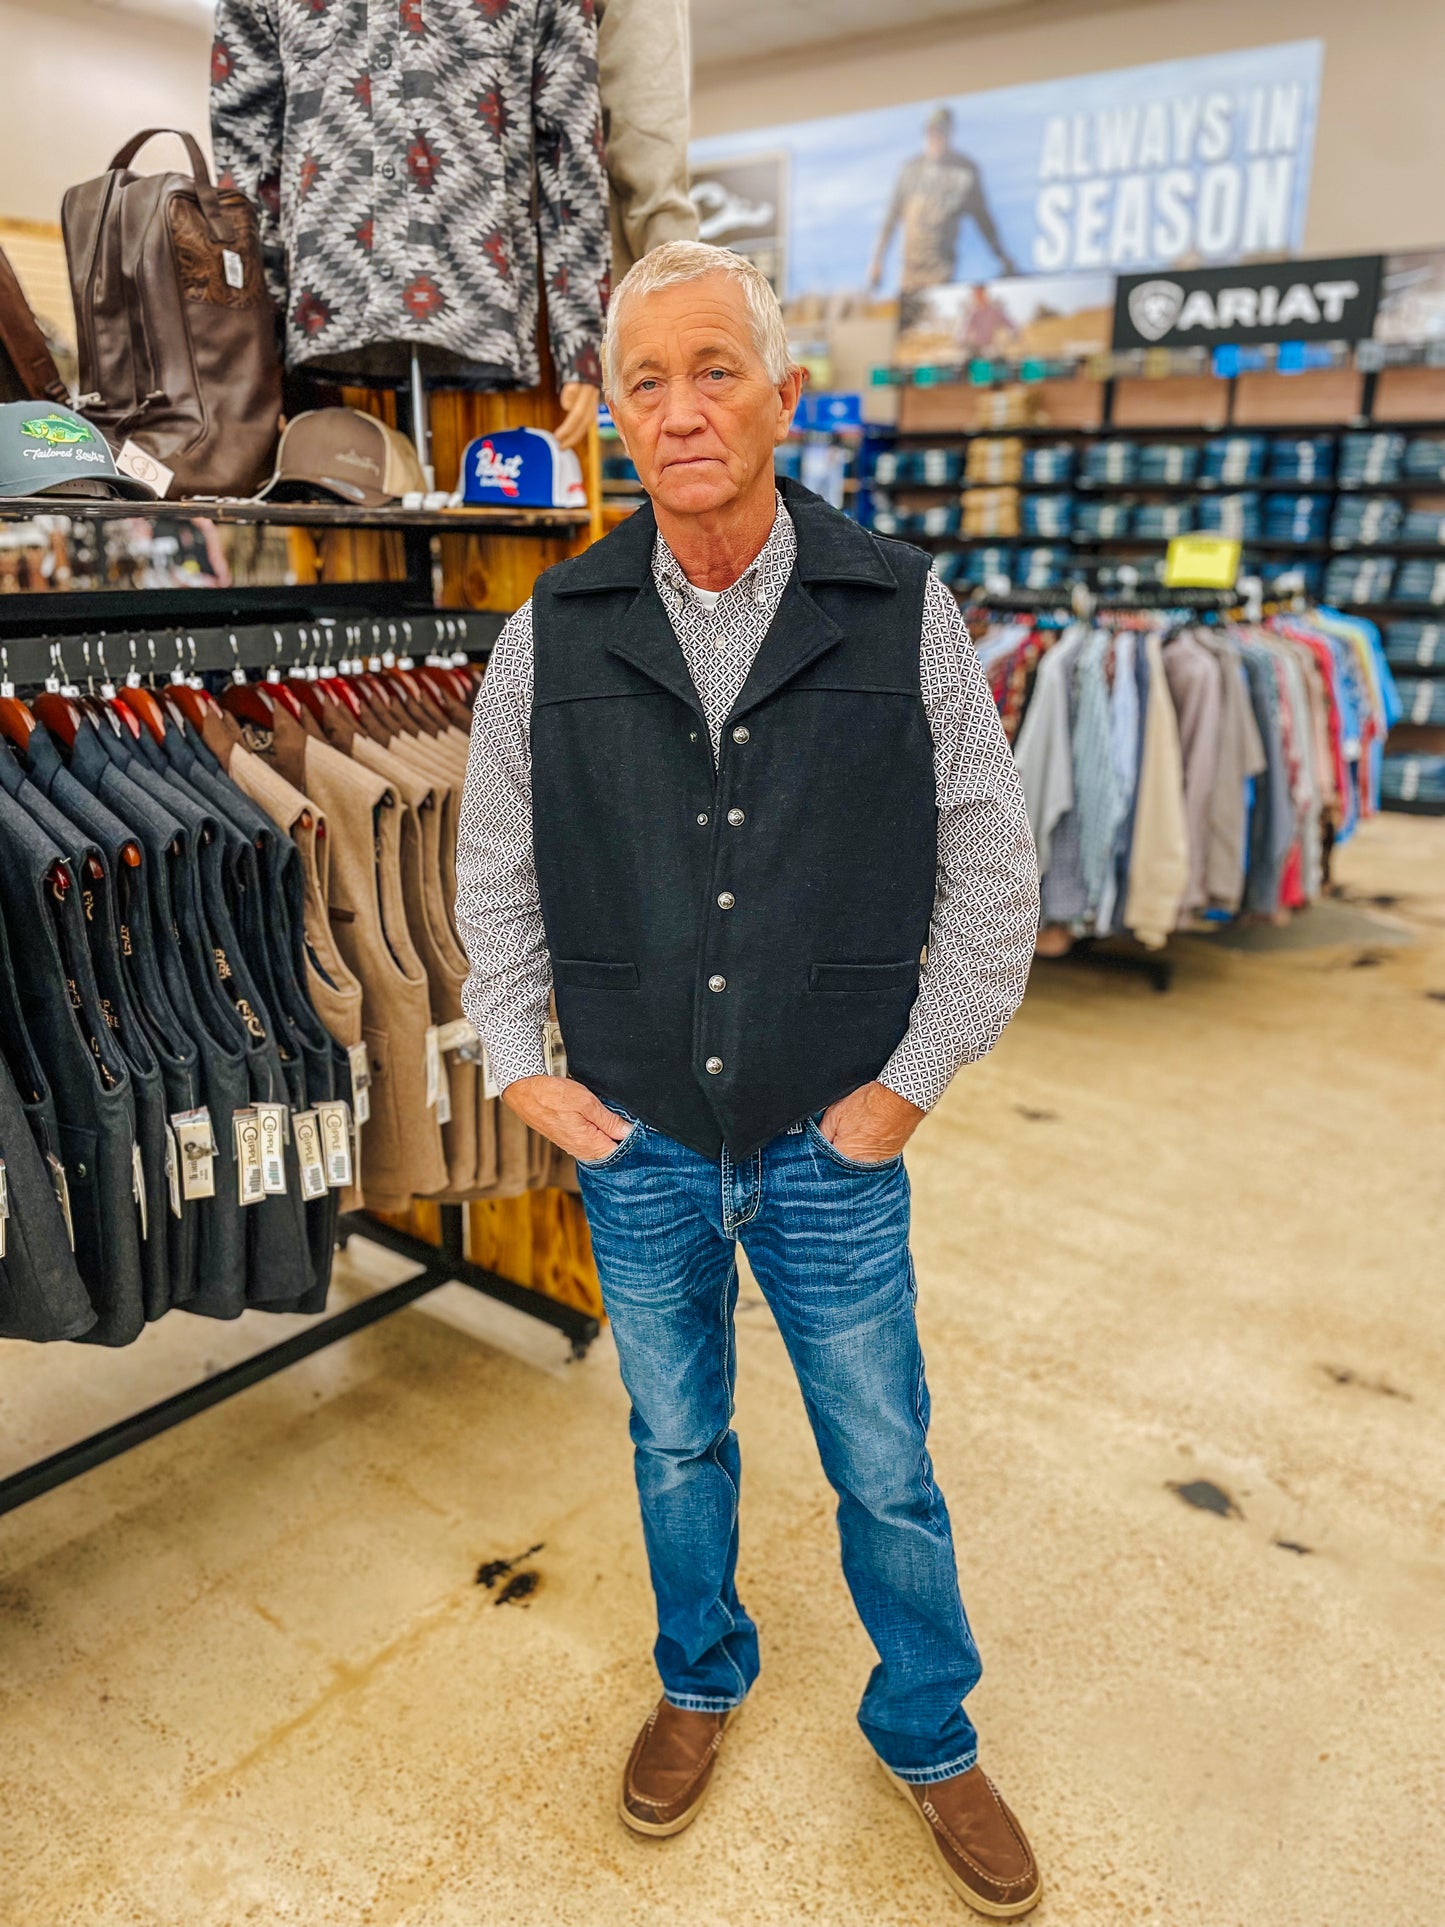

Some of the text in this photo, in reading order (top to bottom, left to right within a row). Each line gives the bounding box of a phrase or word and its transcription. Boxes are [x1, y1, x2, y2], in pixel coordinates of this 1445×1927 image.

[1039, 81, 1300, 178] ALWAYS IN
[1033, 157, 1292, 270] SEASON
[1177, 280, 1360, 331] ARIAT
[23, 448, 73, 460] Tailored
[242, 1126, 258, 1166] CRIPPLE
[263, 1115, 277, 1156] CRIPPLE
